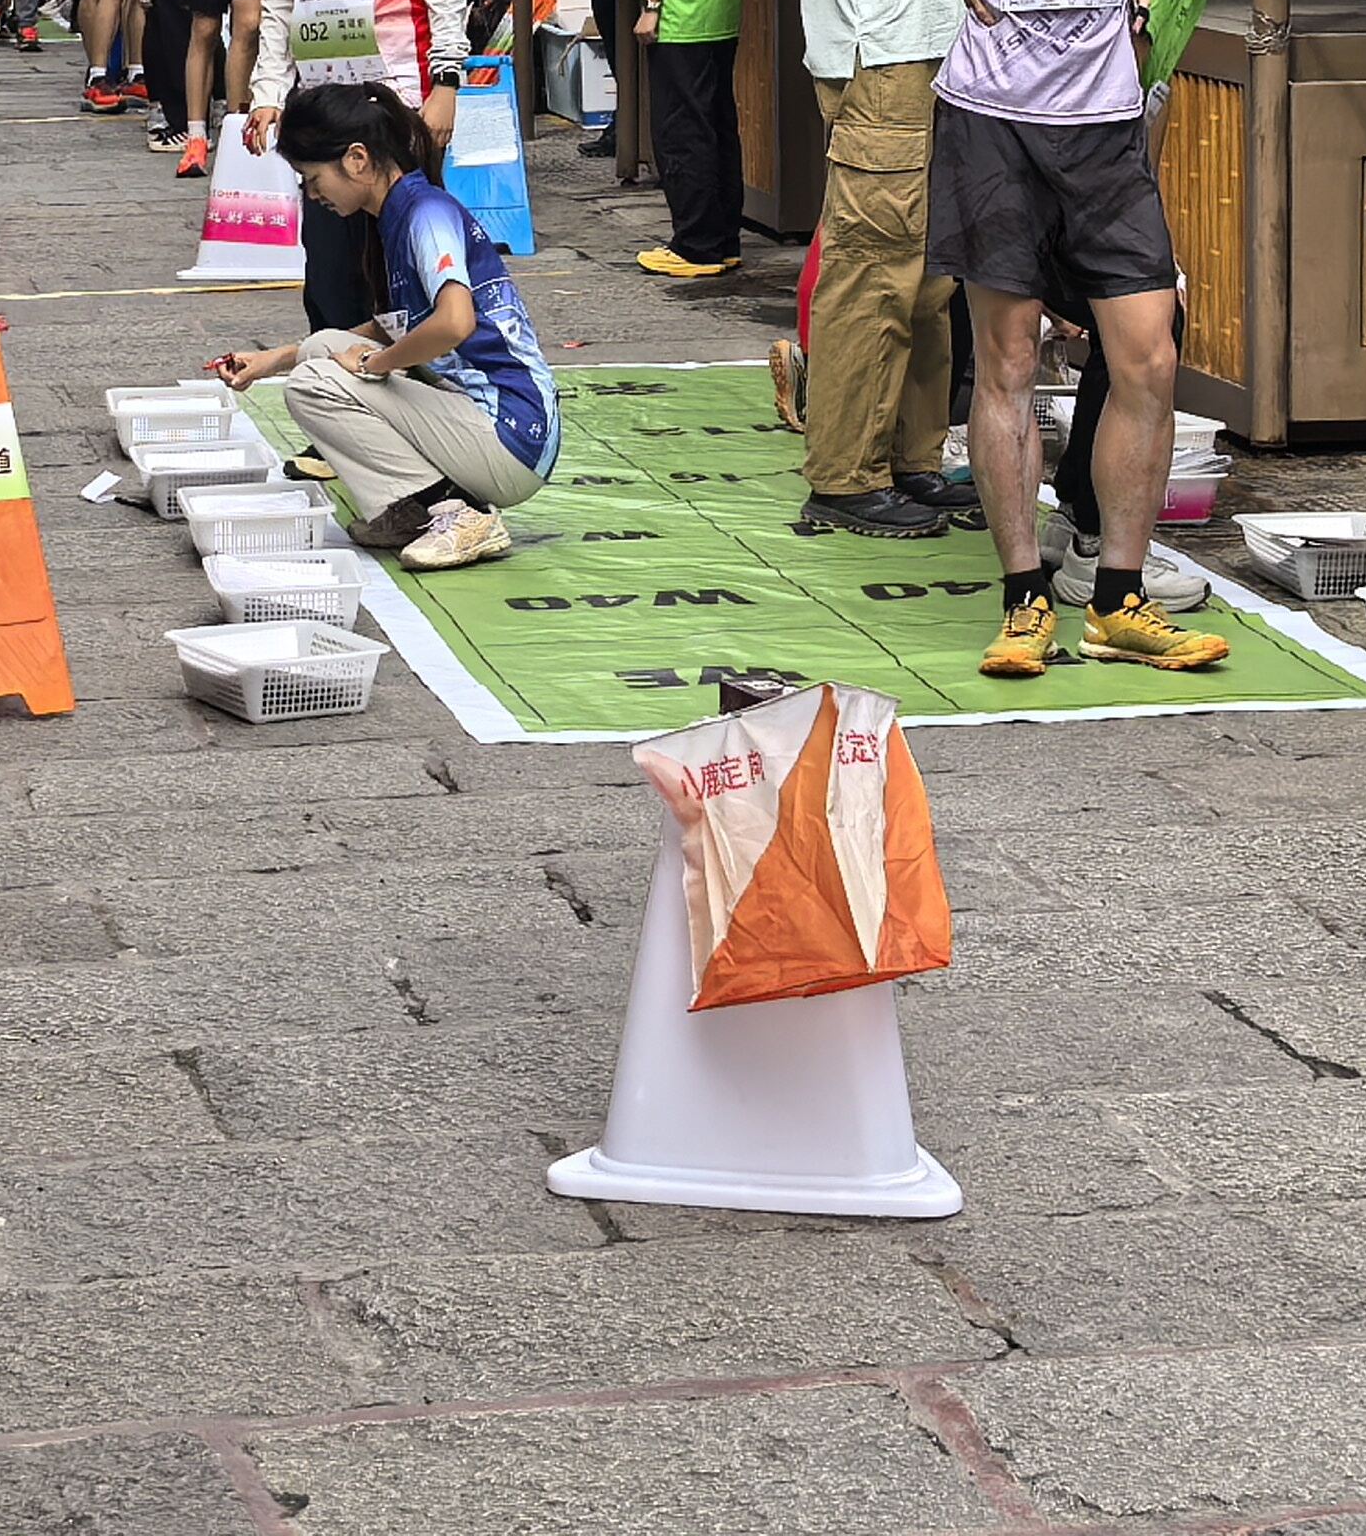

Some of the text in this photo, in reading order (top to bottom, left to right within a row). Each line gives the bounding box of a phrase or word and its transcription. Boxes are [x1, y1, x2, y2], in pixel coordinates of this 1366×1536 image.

[299, 21, 329, 42] 052
[504, 588, 757, 611] W40
[860, 580, 1004, 602] 40
